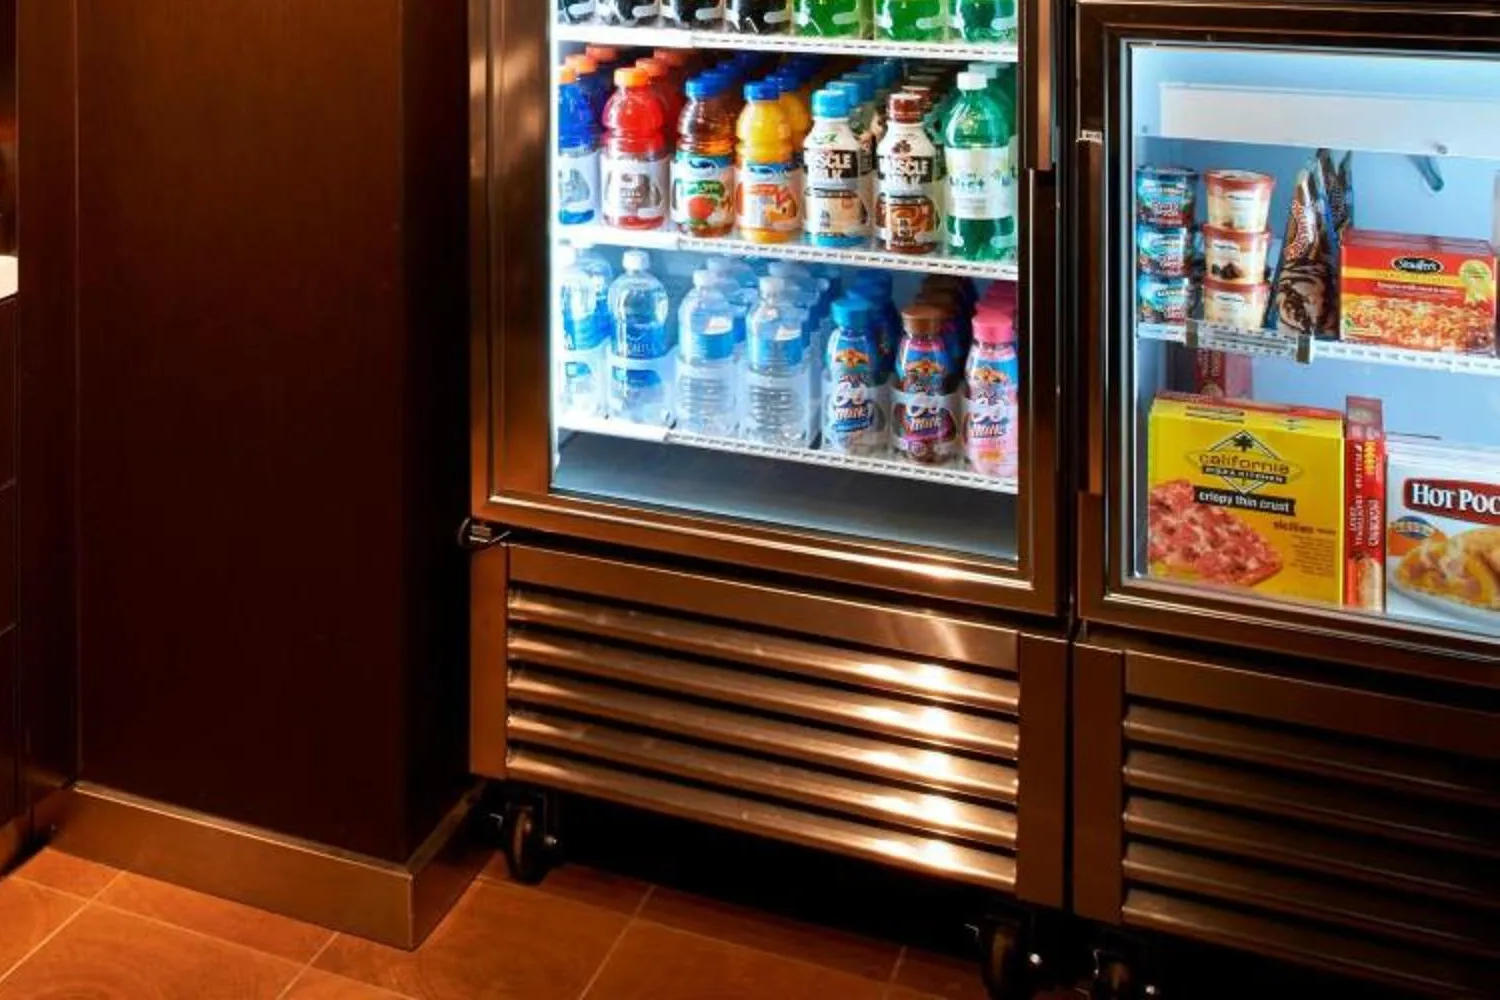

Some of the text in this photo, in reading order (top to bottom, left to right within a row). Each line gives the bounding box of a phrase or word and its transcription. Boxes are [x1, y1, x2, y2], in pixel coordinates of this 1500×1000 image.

[1199, 491, 1290, 513] crispy thin crust
